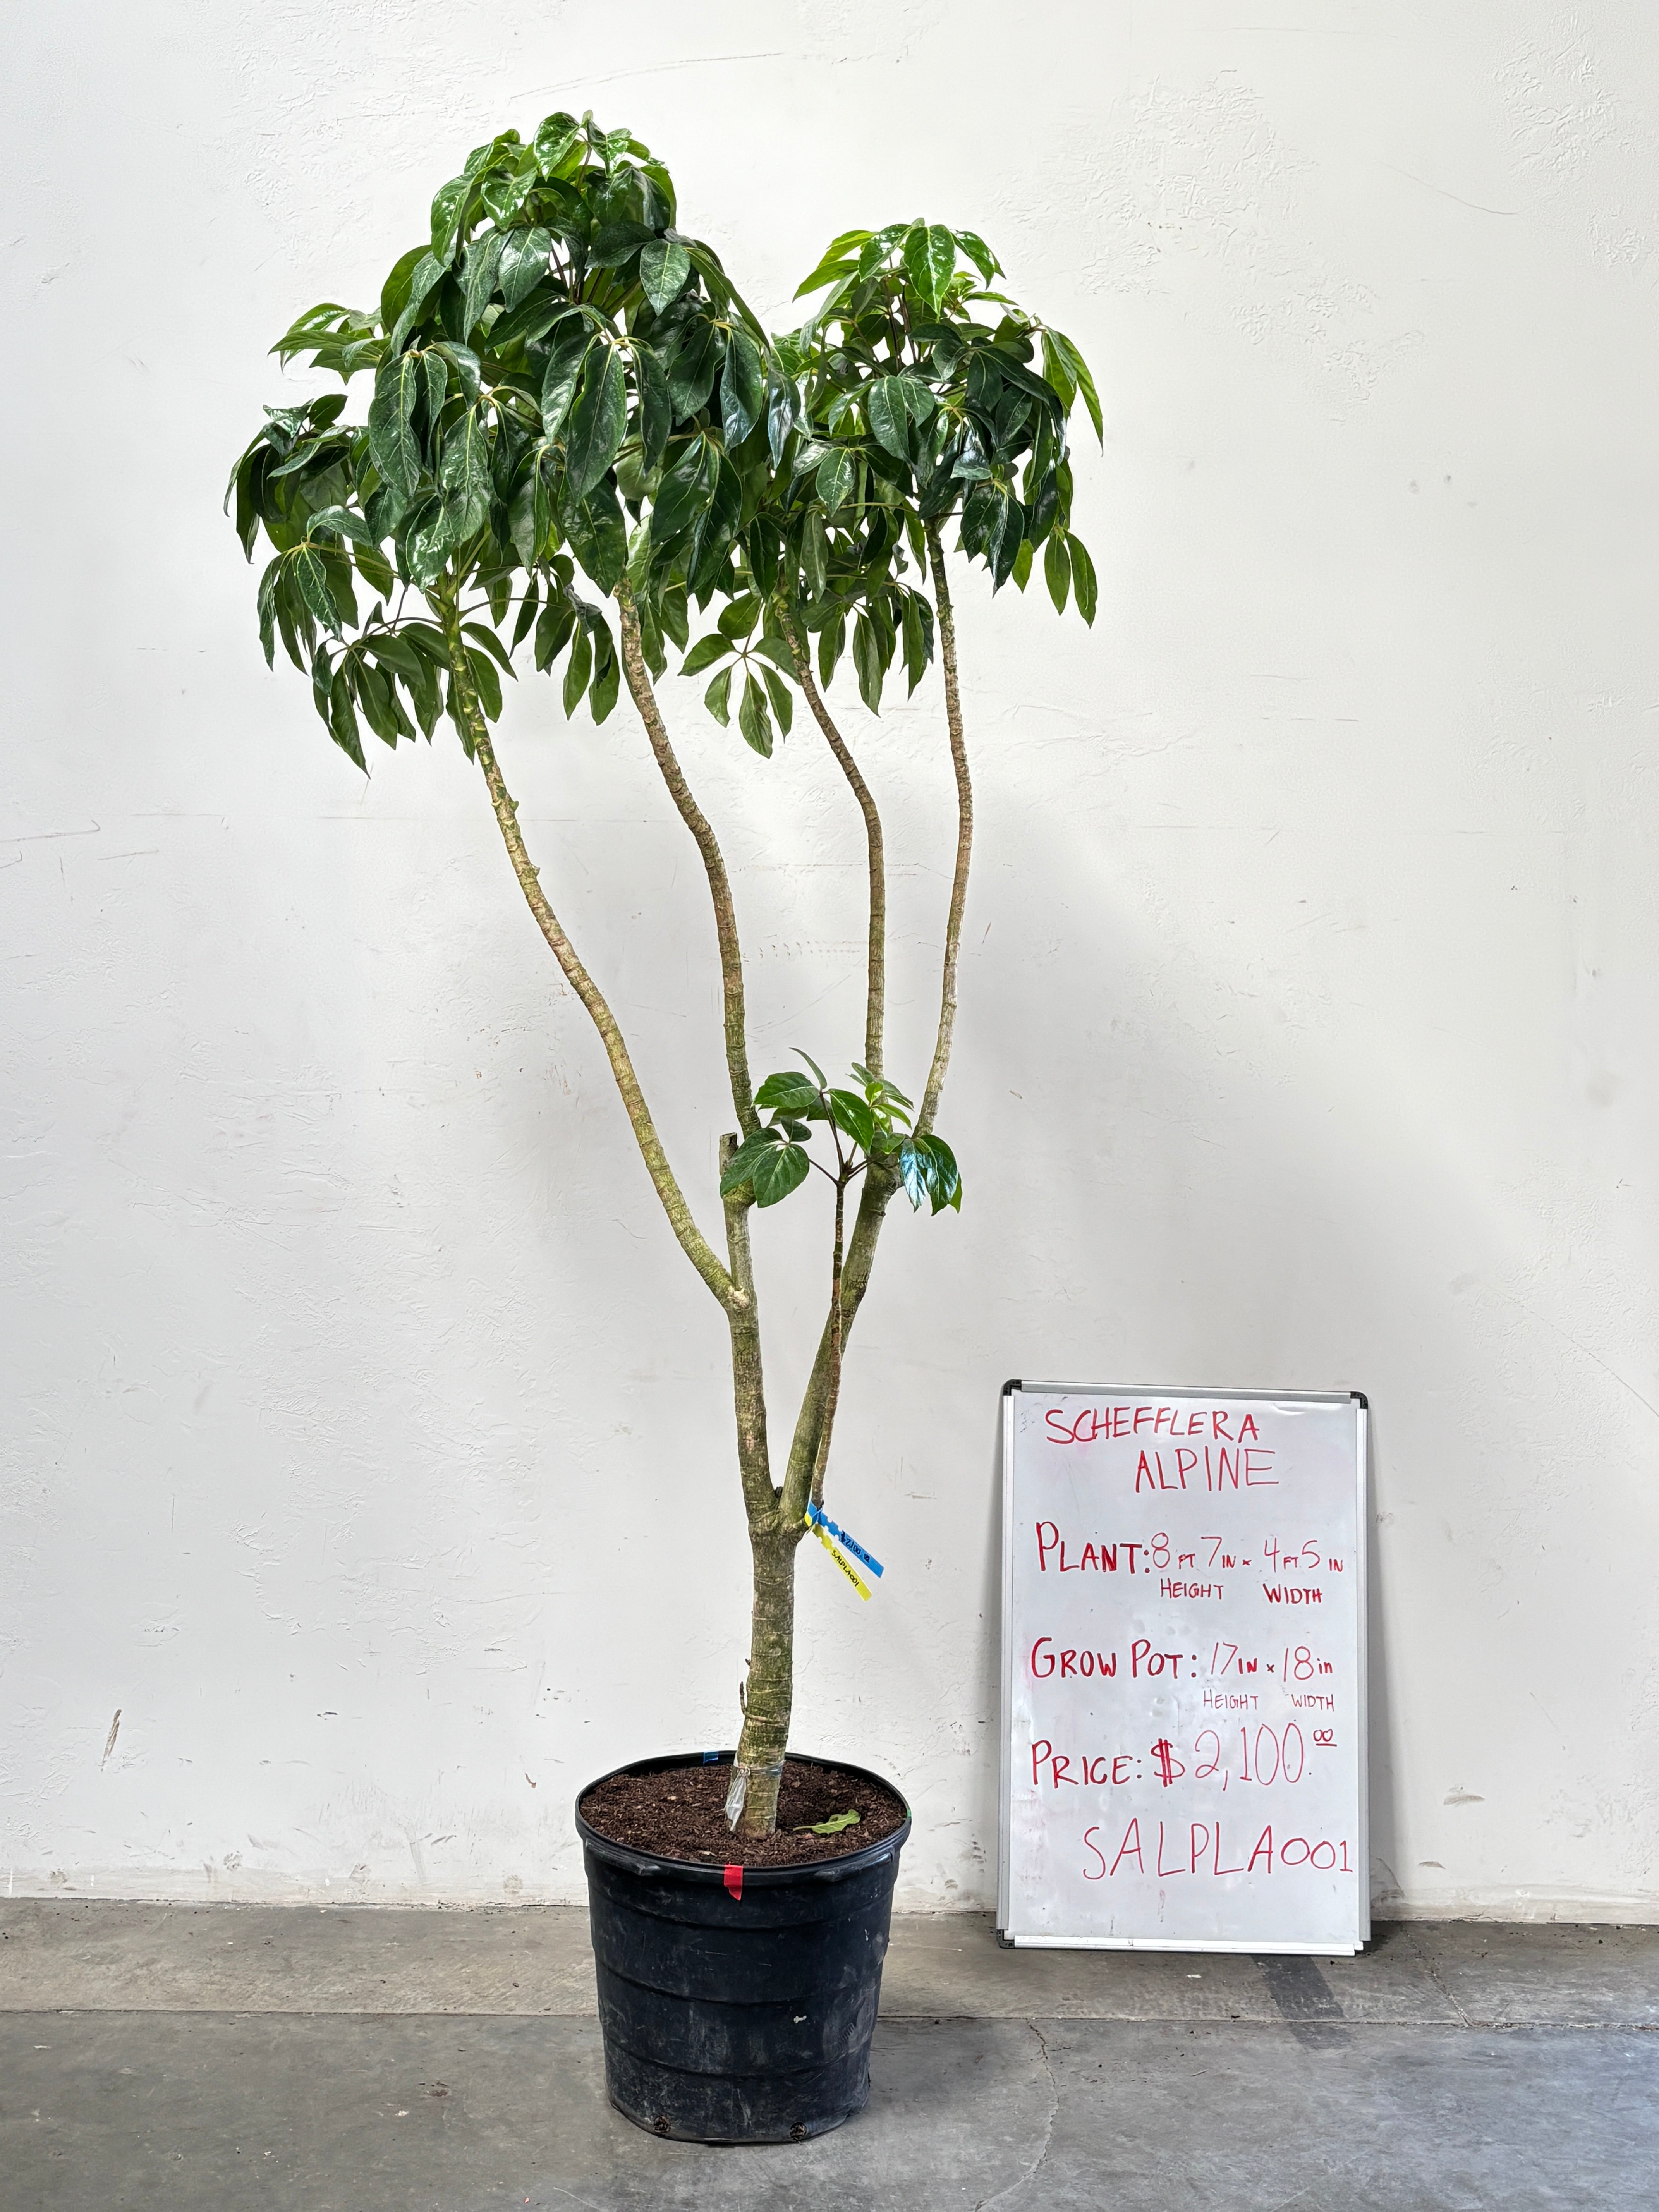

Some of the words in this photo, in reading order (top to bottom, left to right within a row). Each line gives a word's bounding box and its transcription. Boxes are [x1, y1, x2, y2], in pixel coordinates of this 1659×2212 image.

[1044, 1407, 1259, 1444] SCHEFFLERA
[1135, 1446, 1279, 1493] ALPINE
[1036, 1521, 1150, 1574] PLANT:
[1160, 1578, 1224, 1599] HEIGHT
[1262, 1583, 1322, 1604] WIDTH
[1031, 1637, 1116, 1678] GROW
[1131, 1639, 1197, 1679] POT:
[1203, 1689, 1259, 1710] HEIGHT
[1290, 1695, 1334, 1711] WIDTH
[1031, 1740, 1141, 1788] PRICE:
[1083, 1818, 1353, 1879] SALPLA001
